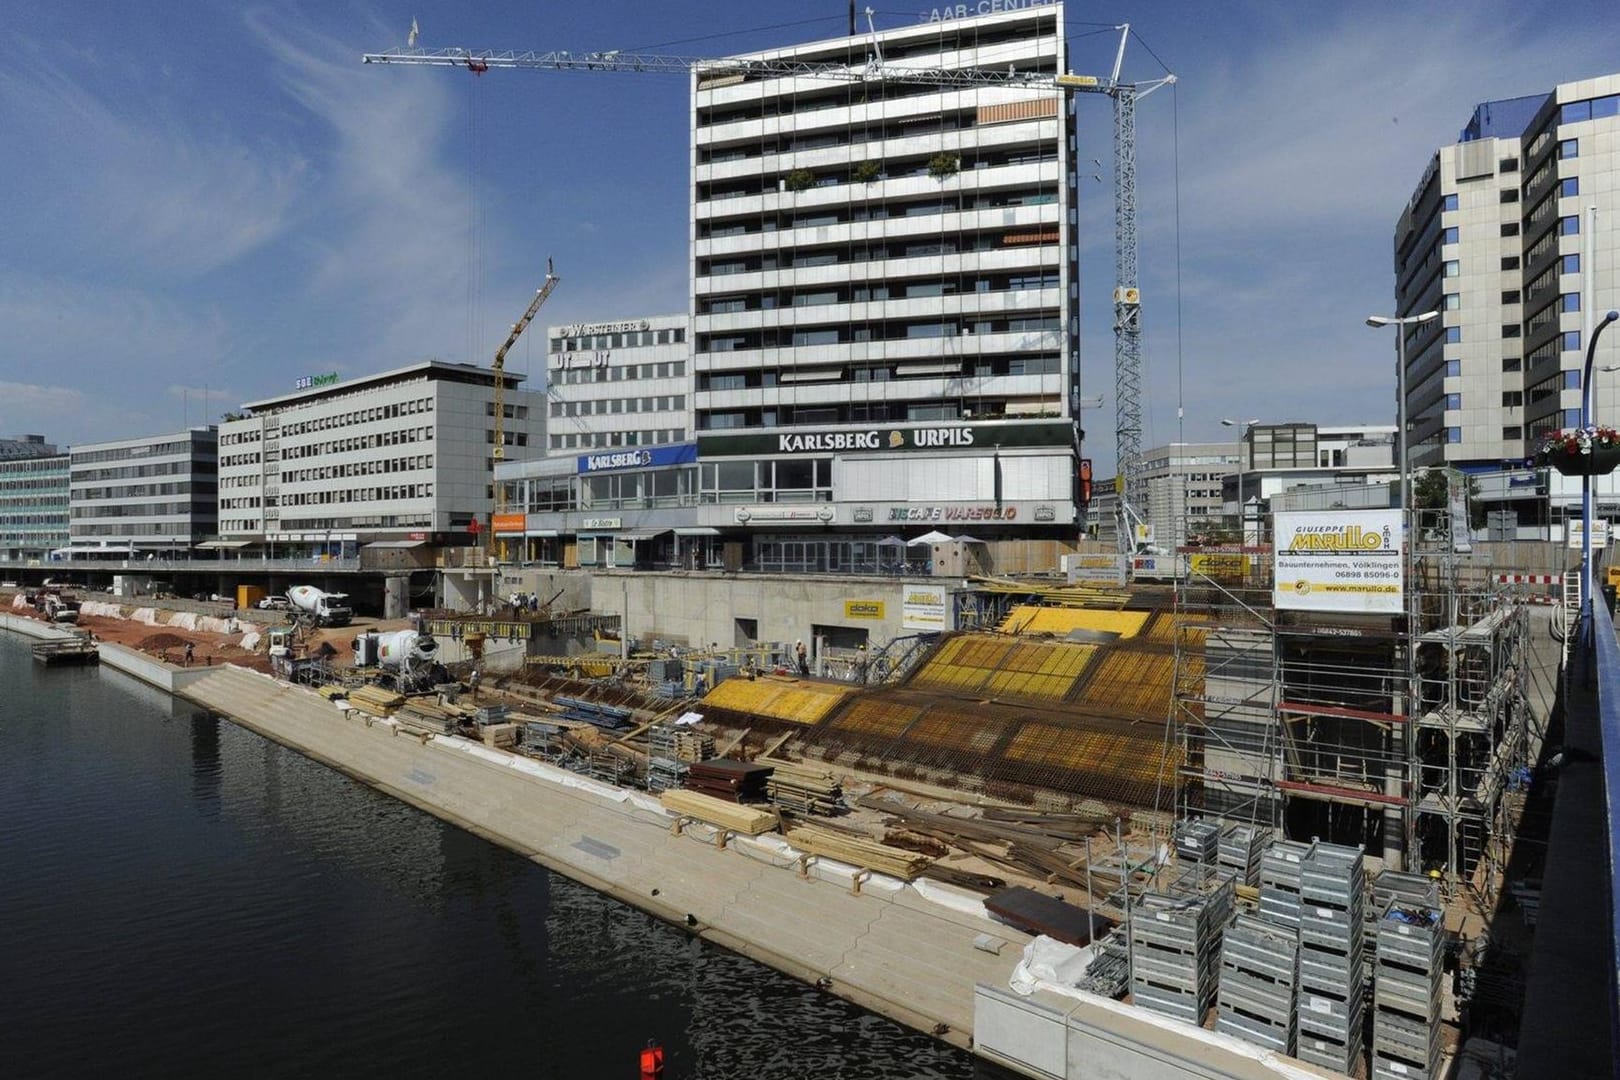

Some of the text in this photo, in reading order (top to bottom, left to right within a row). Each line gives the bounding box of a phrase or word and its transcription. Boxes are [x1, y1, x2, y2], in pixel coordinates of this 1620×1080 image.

[779, 428, 974, 451] KARLSBERG URPILS
[587, 450, 641, 471] KARLSBERG
[944, 505, 1017, 520] VIAREGGIO
[1295, 525, 1346, 533] GIUSEPPE
[1278, 561, 1399, 570] Bauunternehmen, Völklingen
[1325, 585, 1397, 593] www.marullo.de
[850, 603, 879, 612] doka
